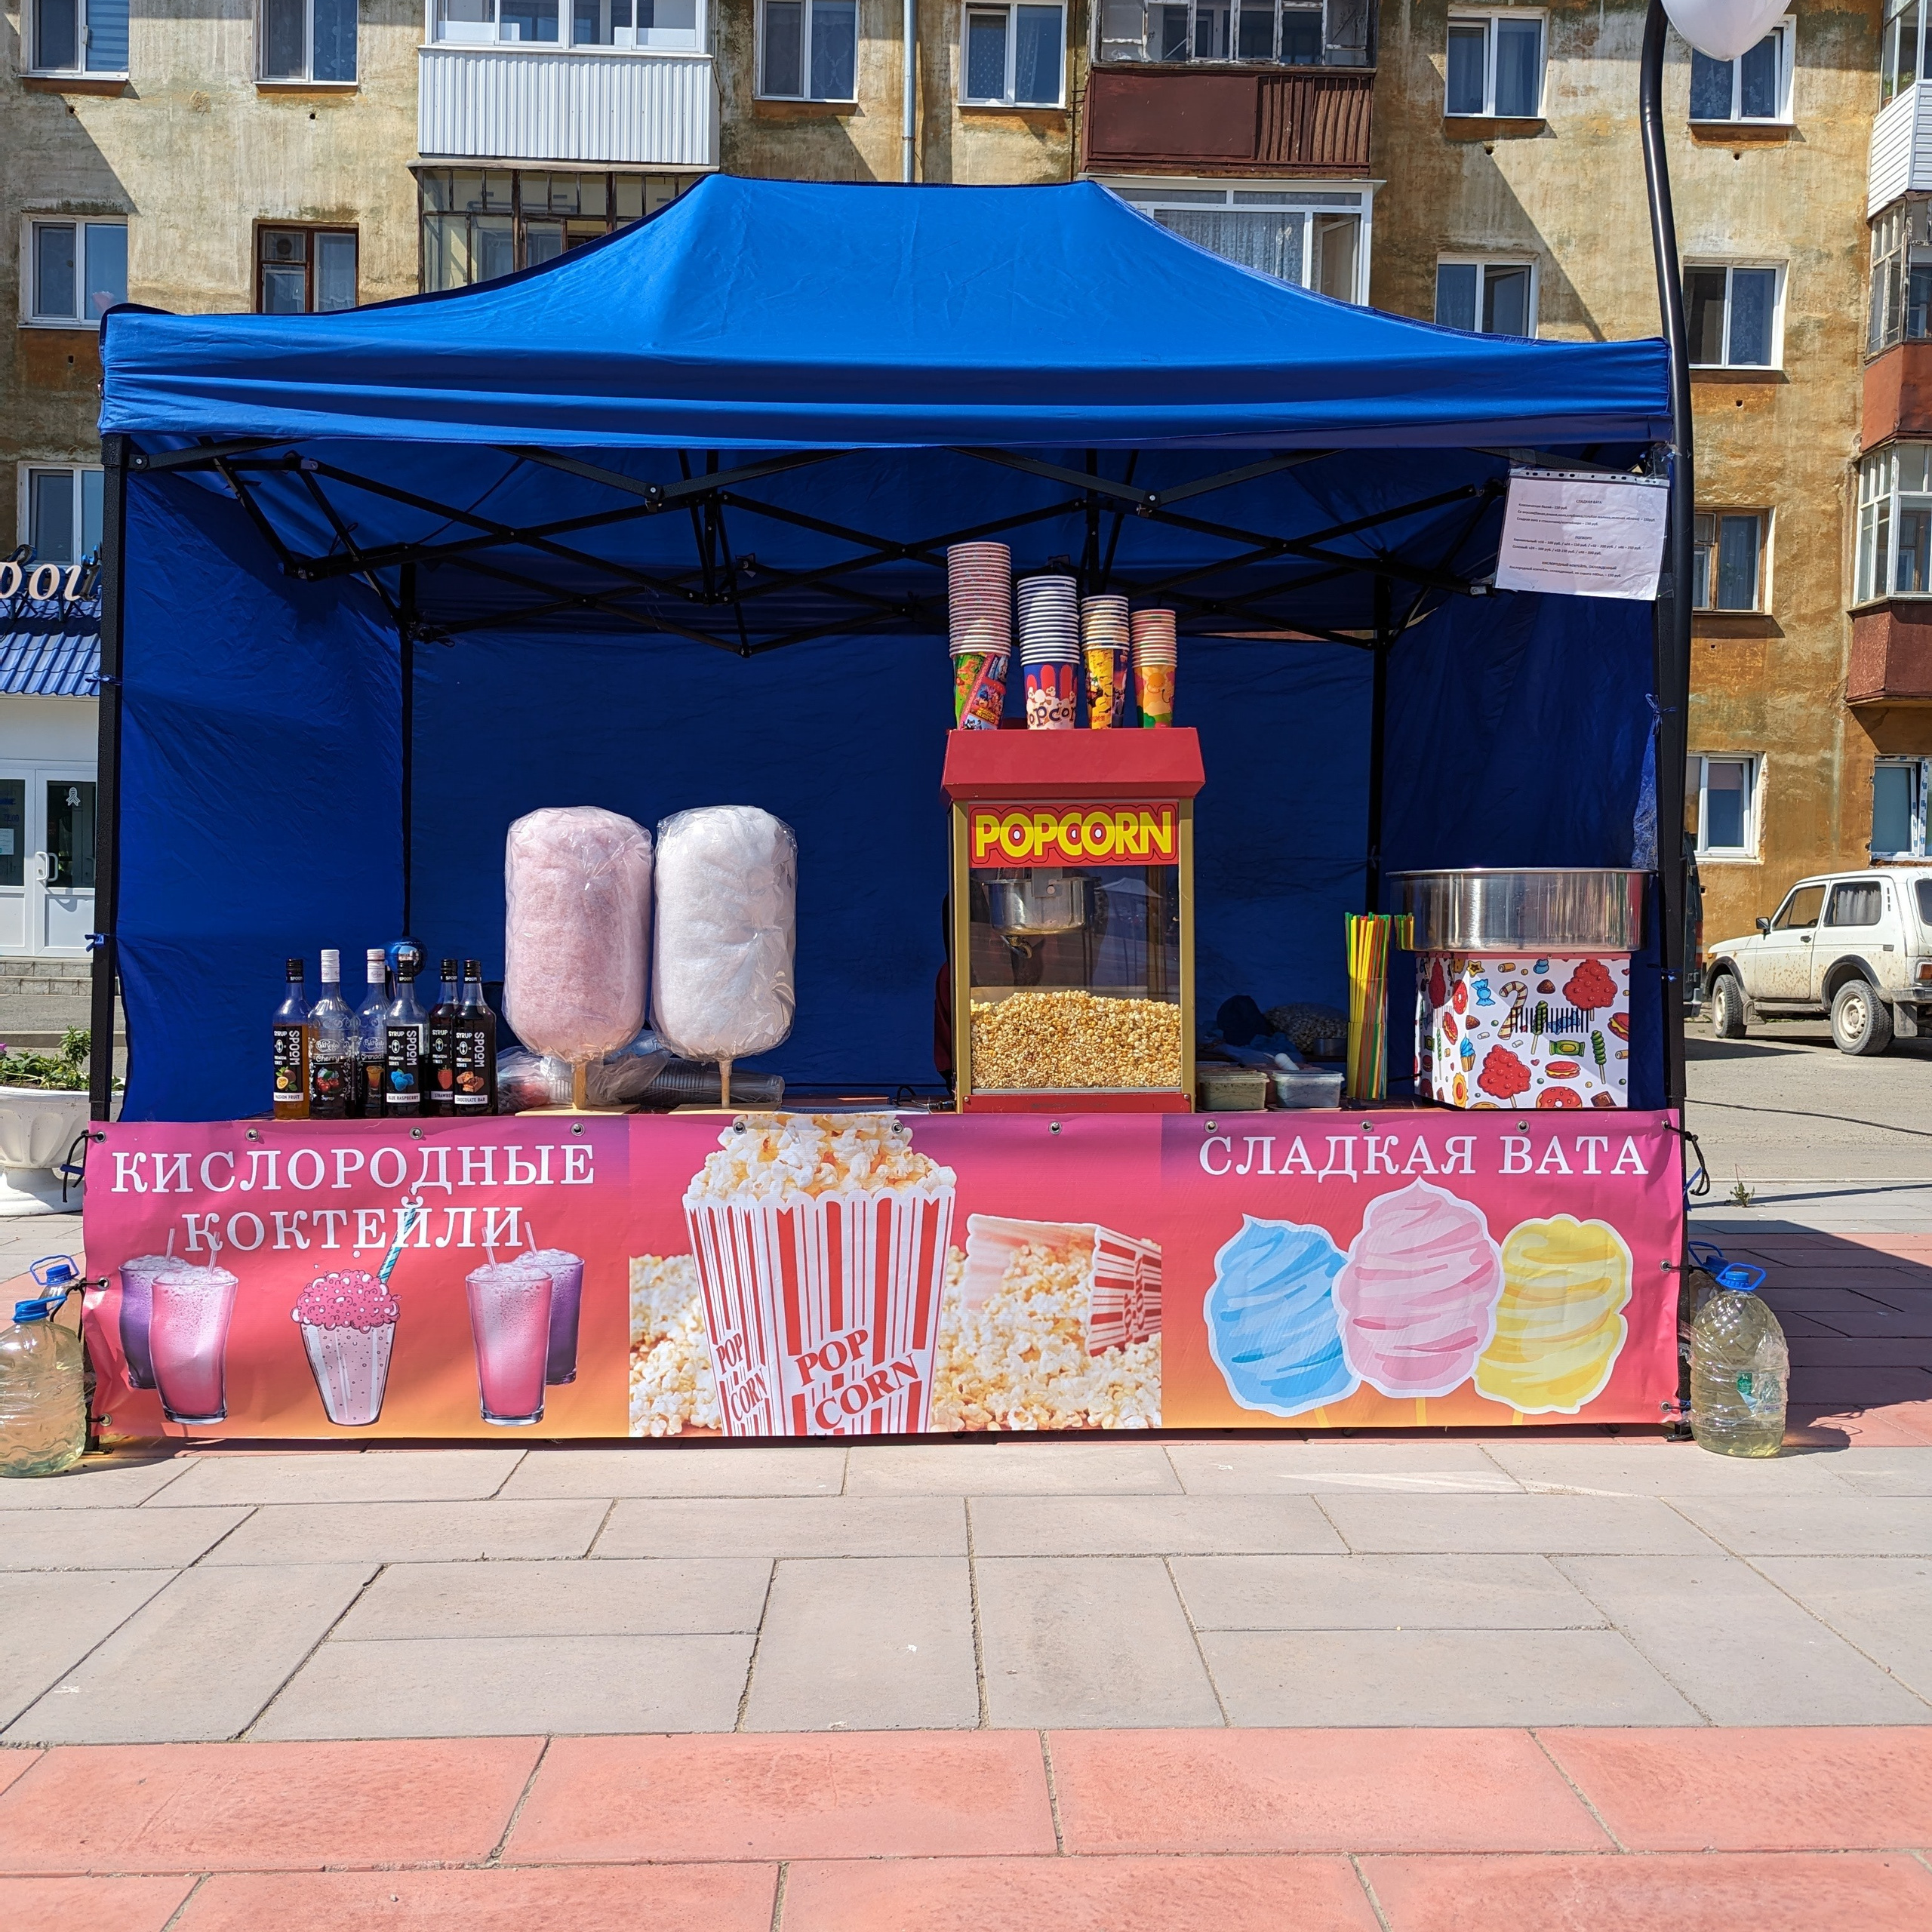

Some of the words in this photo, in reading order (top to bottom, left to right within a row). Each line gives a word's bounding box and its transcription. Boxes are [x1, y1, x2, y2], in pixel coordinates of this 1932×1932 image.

[976, 811, 1172, 857] POPCORN
[289, 1030, 300, 1066] SPOOM
[407, 1030, 417, 1066] SPOOM
[474, 1032, 485, 1067] SPOOM
[110, 1144, 595, 1195] КИСЛОРОДНЫЕ
[1198, 1135, 1477, 1183] СЛАДКАЯ
[1499, 1135, 1649, 1175] ВАТА
[182, 1196, 524, 1253] КОКТЕЙЛИ
[715, 1333, 744, 1375] POP
[794, 1329, 869, 1387] POP
[731, 1367, 768, 1422] CORN
[814, 1353, 919, 1430] CORN
